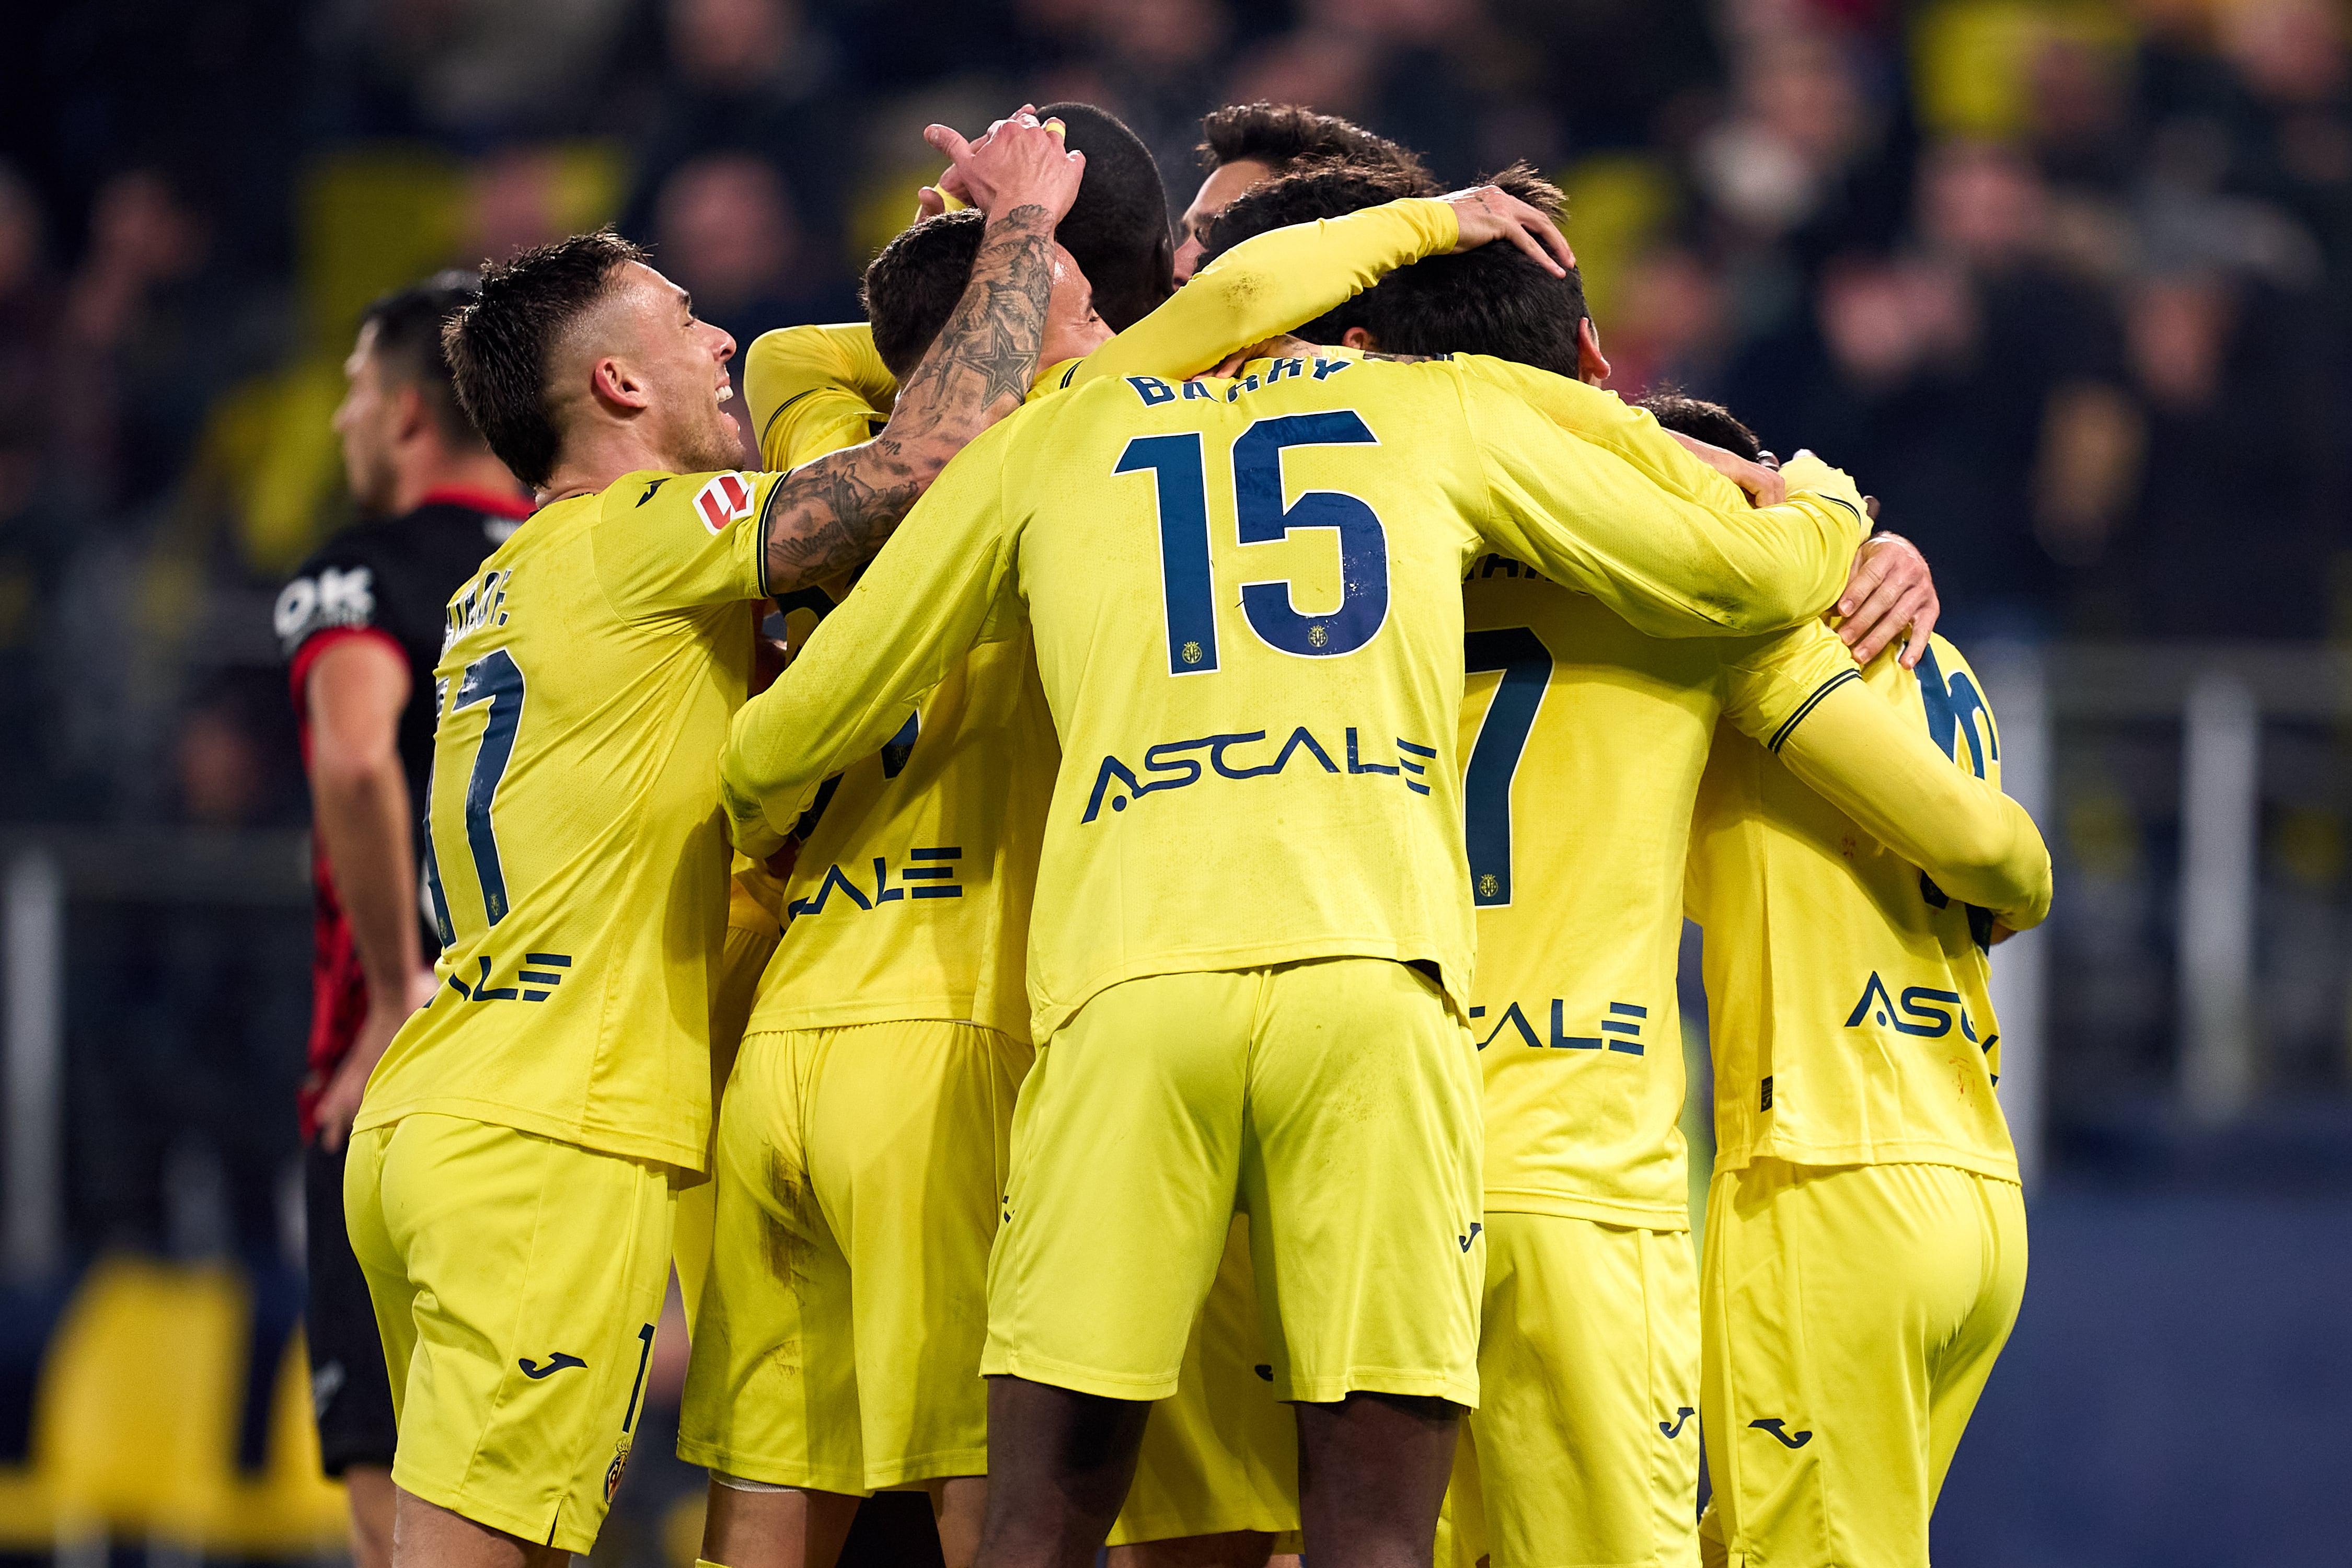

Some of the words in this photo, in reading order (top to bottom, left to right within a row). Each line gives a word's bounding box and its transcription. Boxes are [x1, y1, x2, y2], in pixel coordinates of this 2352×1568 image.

[1123, 356, 1354, 408] BARRY
[1110, 408, 1382, 677] 15
[274, 566, 374, 637] OK
[1081, 725, 1437, 825] ASCALE
